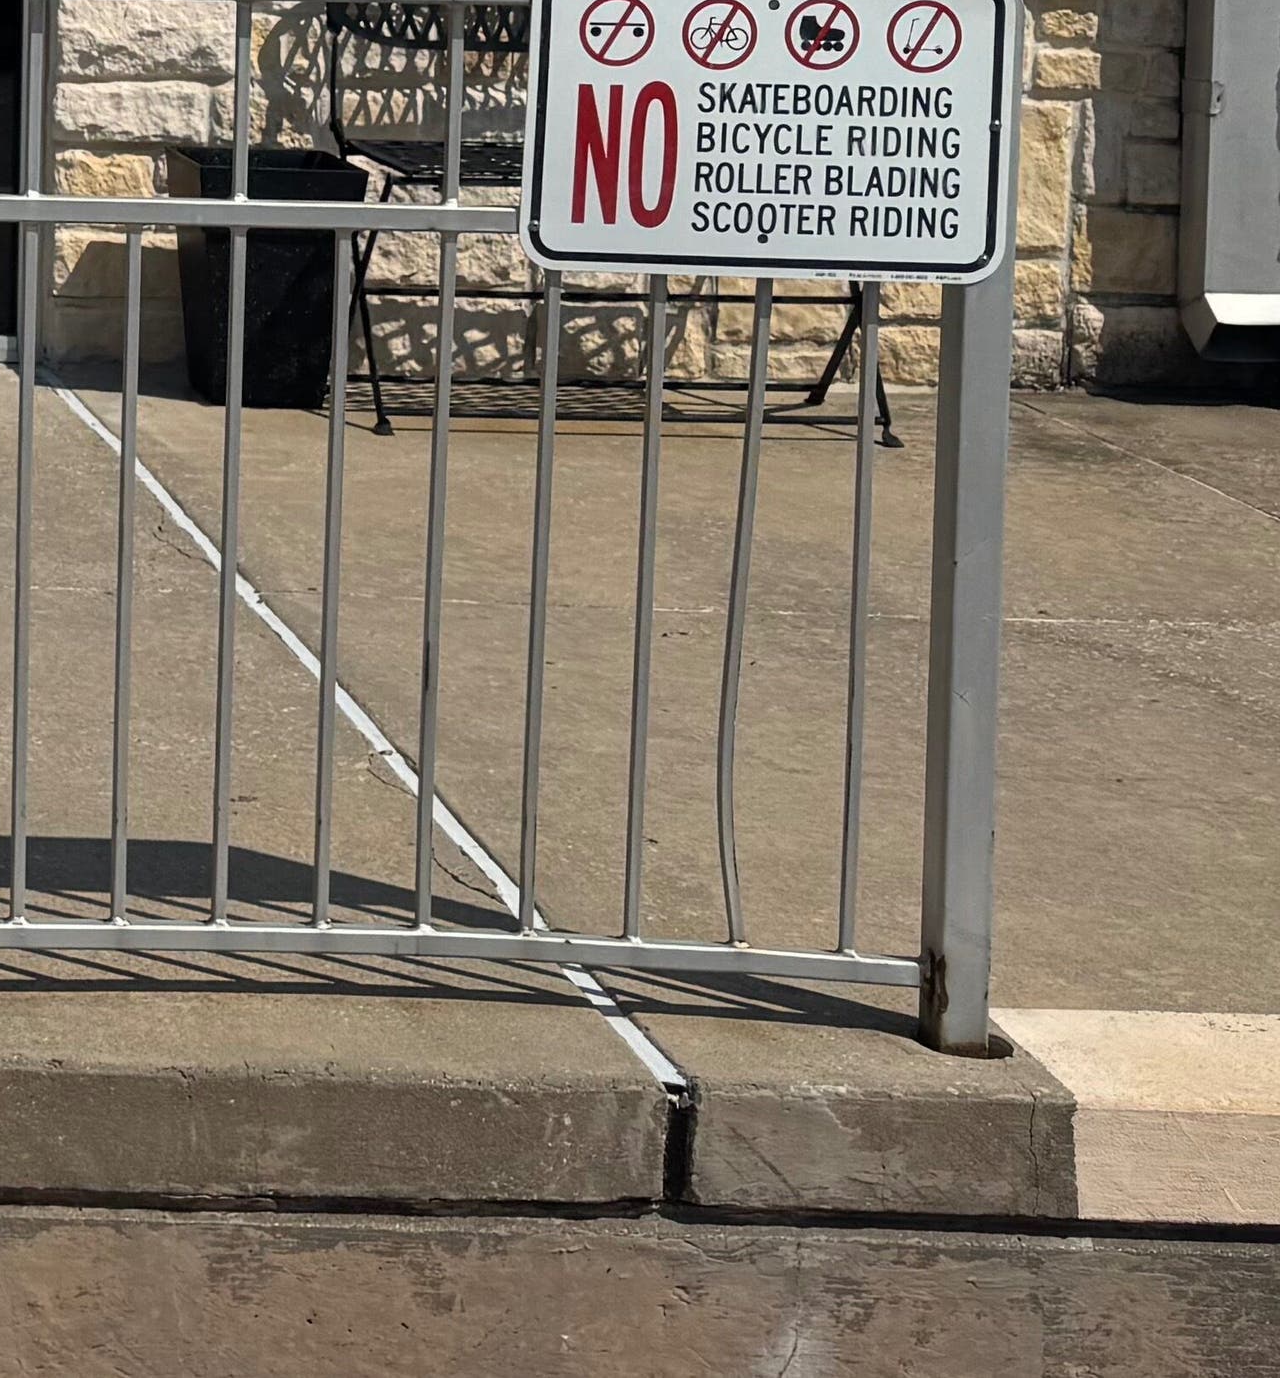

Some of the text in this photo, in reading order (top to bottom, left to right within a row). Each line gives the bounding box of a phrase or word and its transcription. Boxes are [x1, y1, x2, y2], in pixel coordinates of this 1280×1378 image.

[697, 82, 953, 119] SKATEBOARDING
[570, 80, 678, 229] NO
[696, 122, 961, 160] BICYCLE RIDING
[694, 161, 961, 200] ROLLER BLADING
[691, 201, 959, 240] SCOOTER RIDING
